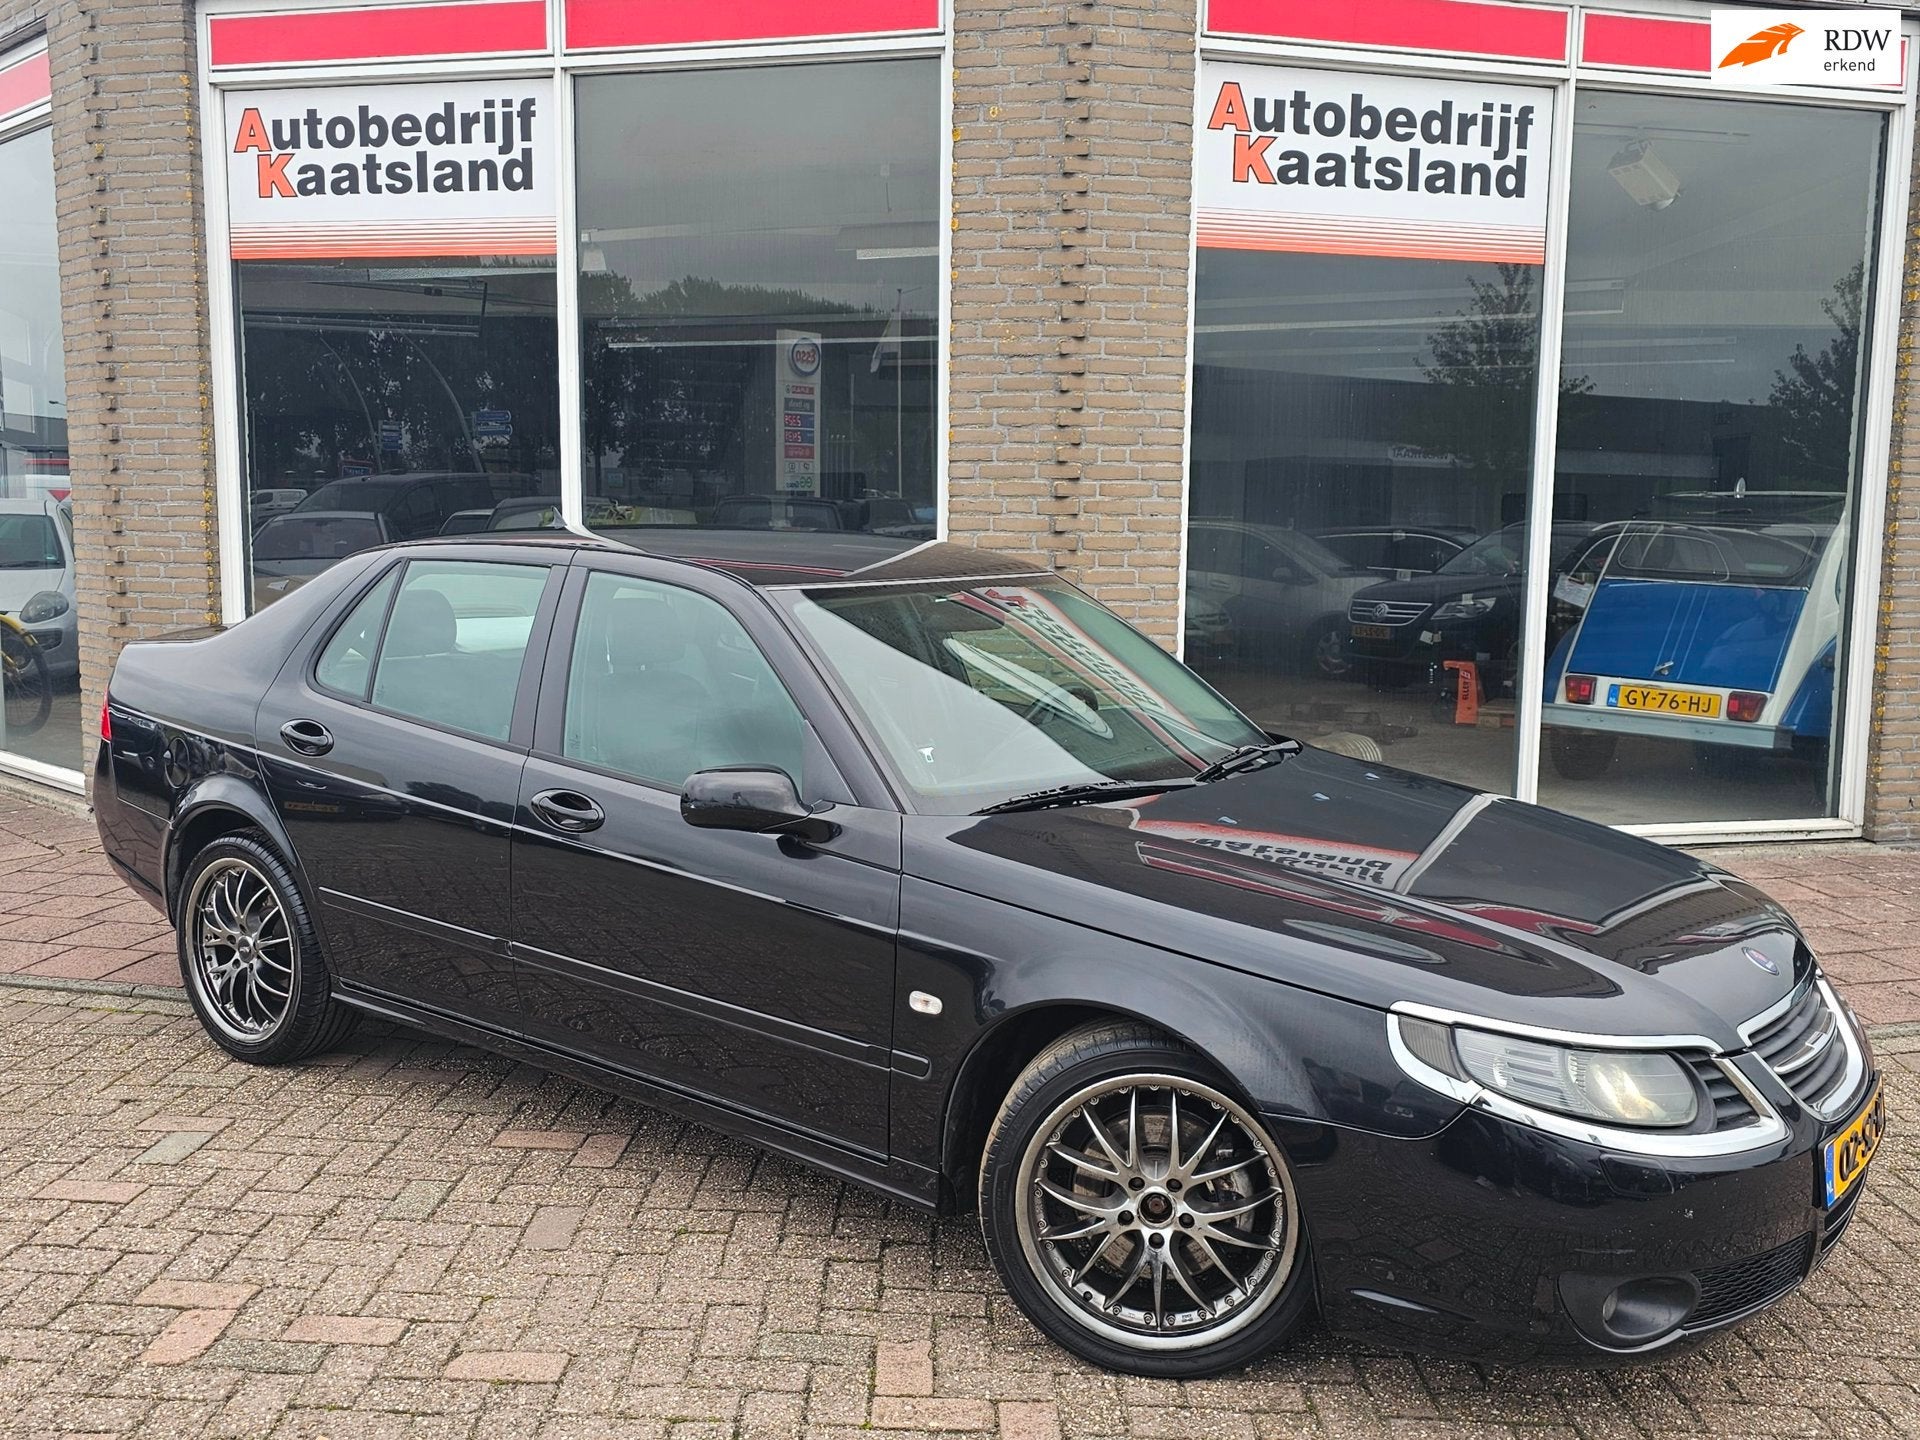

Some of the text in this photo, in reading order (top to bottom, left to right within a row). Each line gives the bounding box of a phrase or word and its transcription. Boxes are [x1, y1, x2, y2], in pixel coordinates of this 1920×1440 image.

[233, 97, 536, 155] Autobedrijf
[1207, 81, 1535, 161] Autobedrijf
[257, 147, 534, 198] Kaatsland
[1232, 134, 1528, 199] Kaatsland
[1625, 689, 1712, 714] GY-76-HJ
